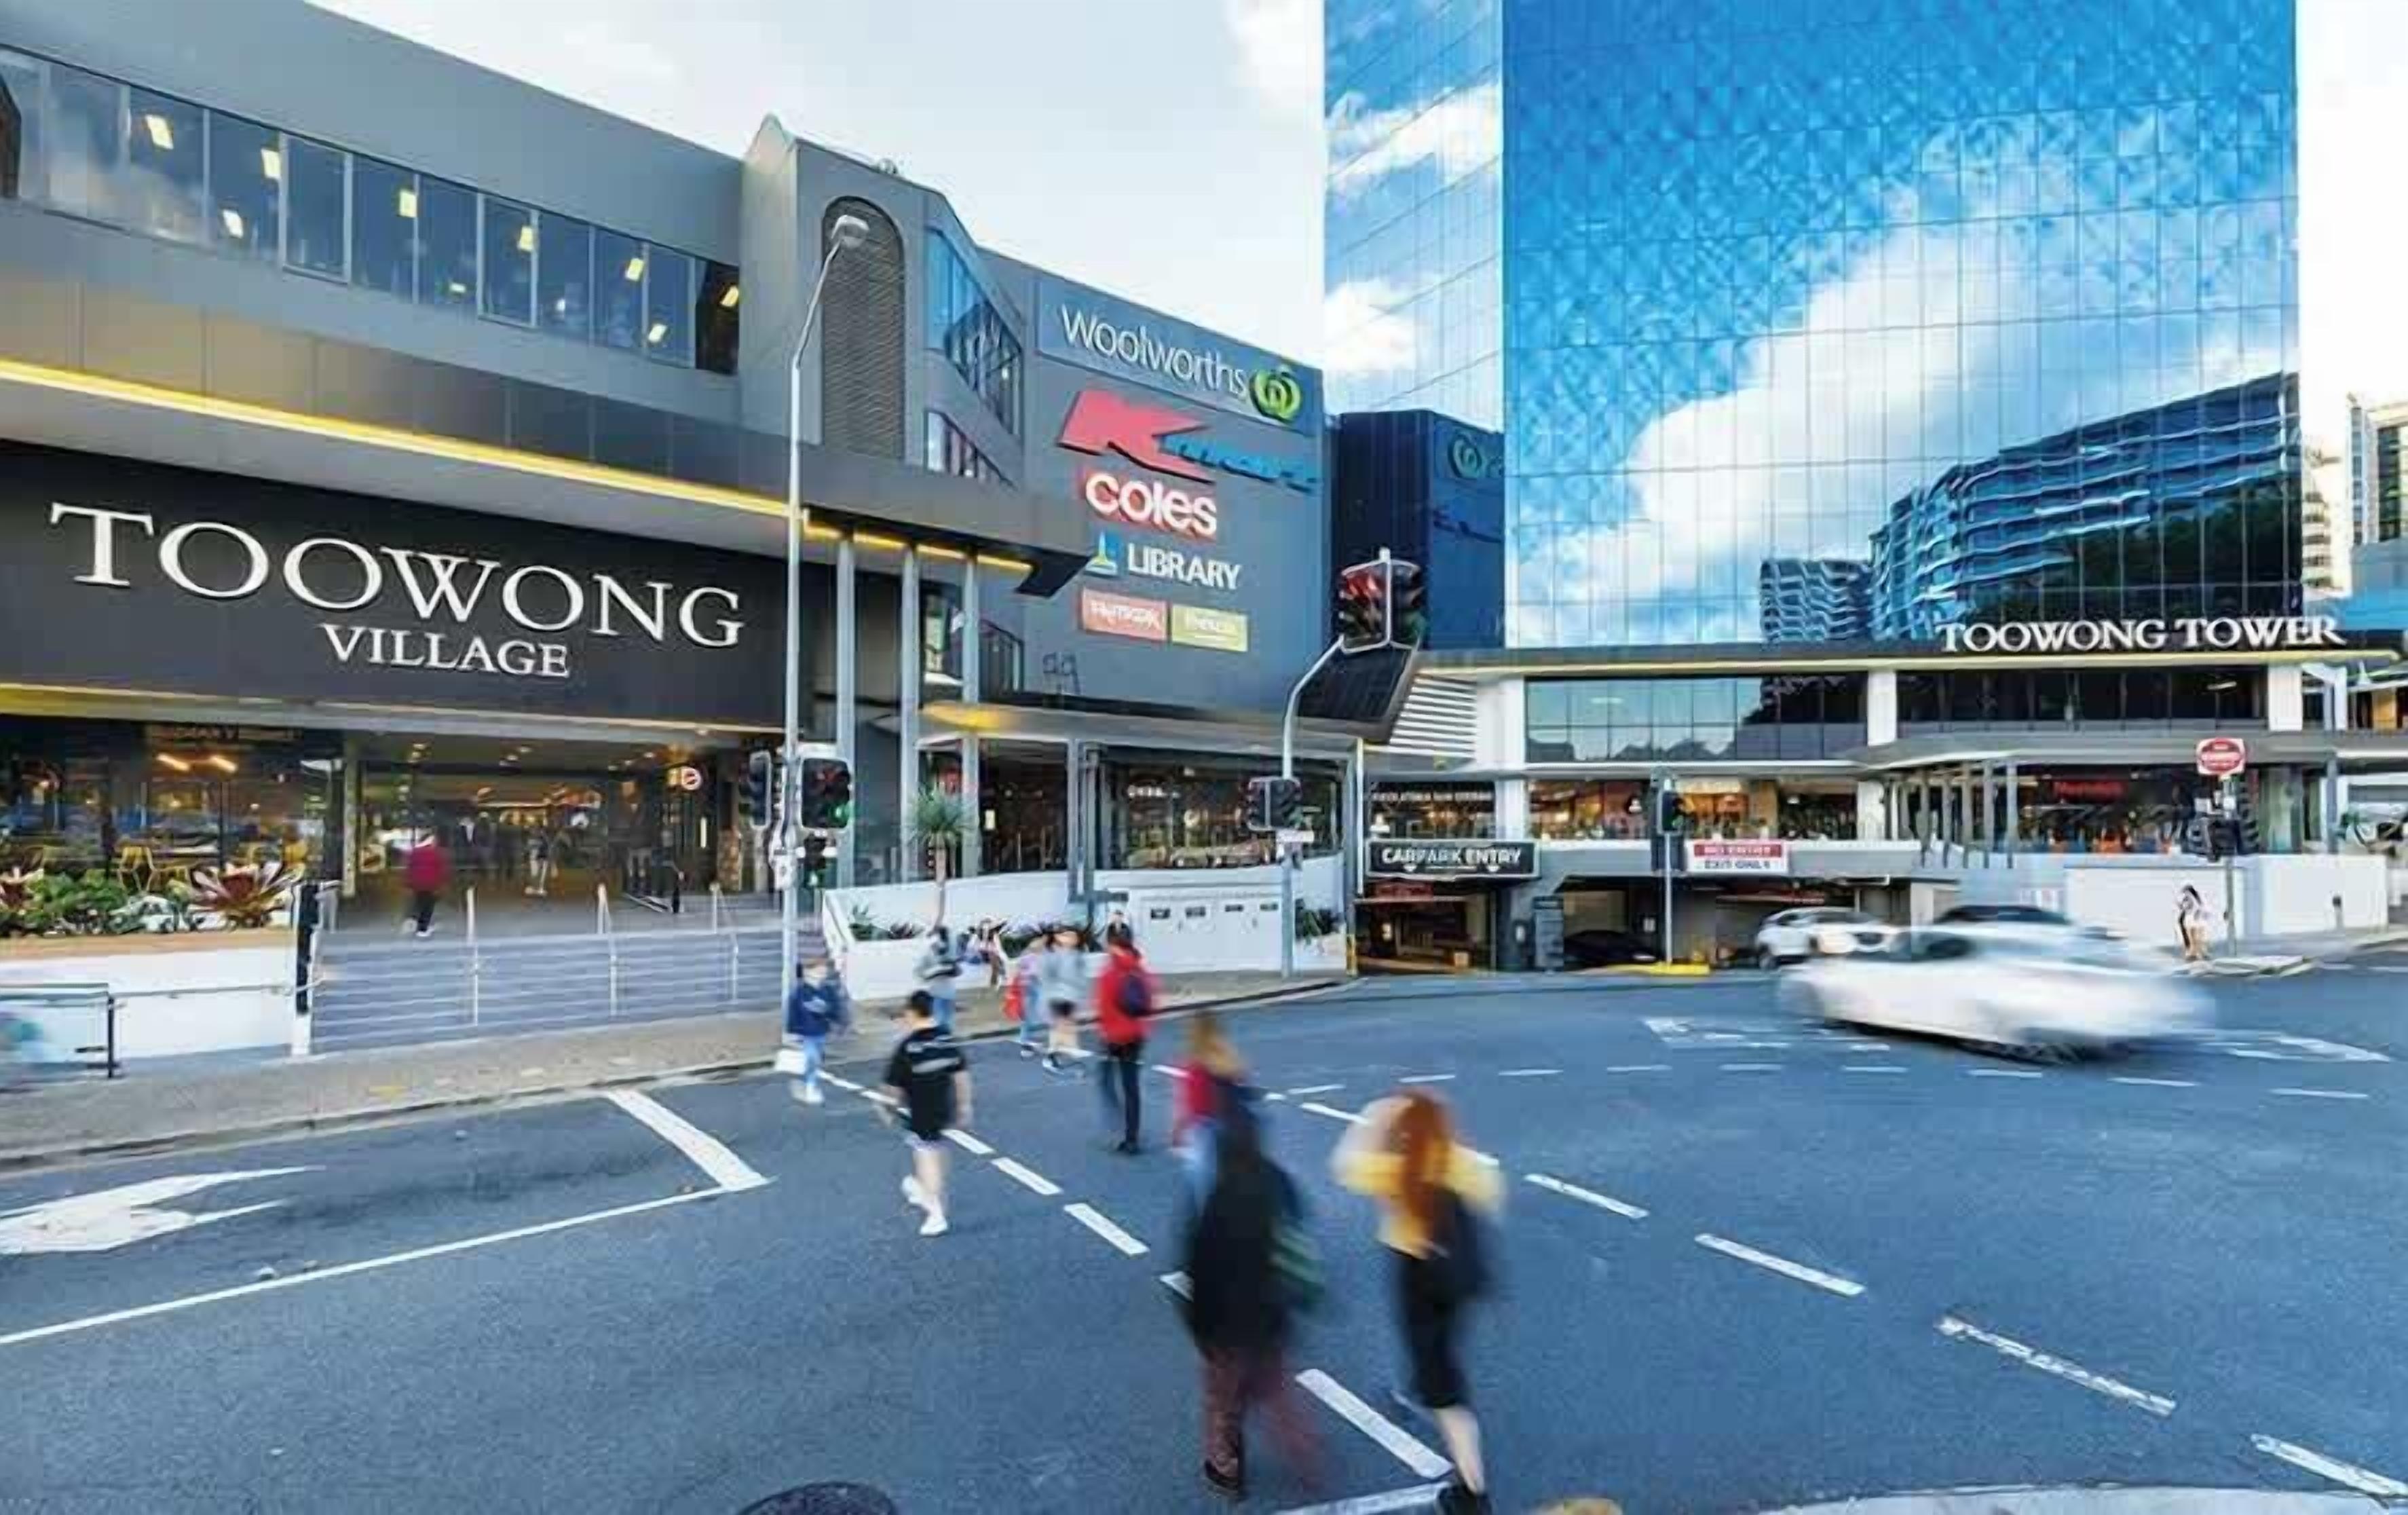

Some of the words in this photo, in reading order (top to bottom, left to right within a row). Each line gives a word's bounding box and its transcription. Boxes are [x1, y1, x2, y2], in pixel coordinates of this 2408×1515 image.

[1061, 303, 1247, 399] Woolworths
[1085, 472, 1218, 537] coles
[50, 502, 744, 649] TOOWONG
[1127, 542, 1242, 590] LIBRARY
[320, 622, 570, 679] VILLAGE
[1935, 619, 2166, 652] TOOWONG
[2173, 616, 2348, 647] TOWER
[1381, 847, 1462, 864] CARPARK
[1464, 847, 1522, 864] ENTRY
